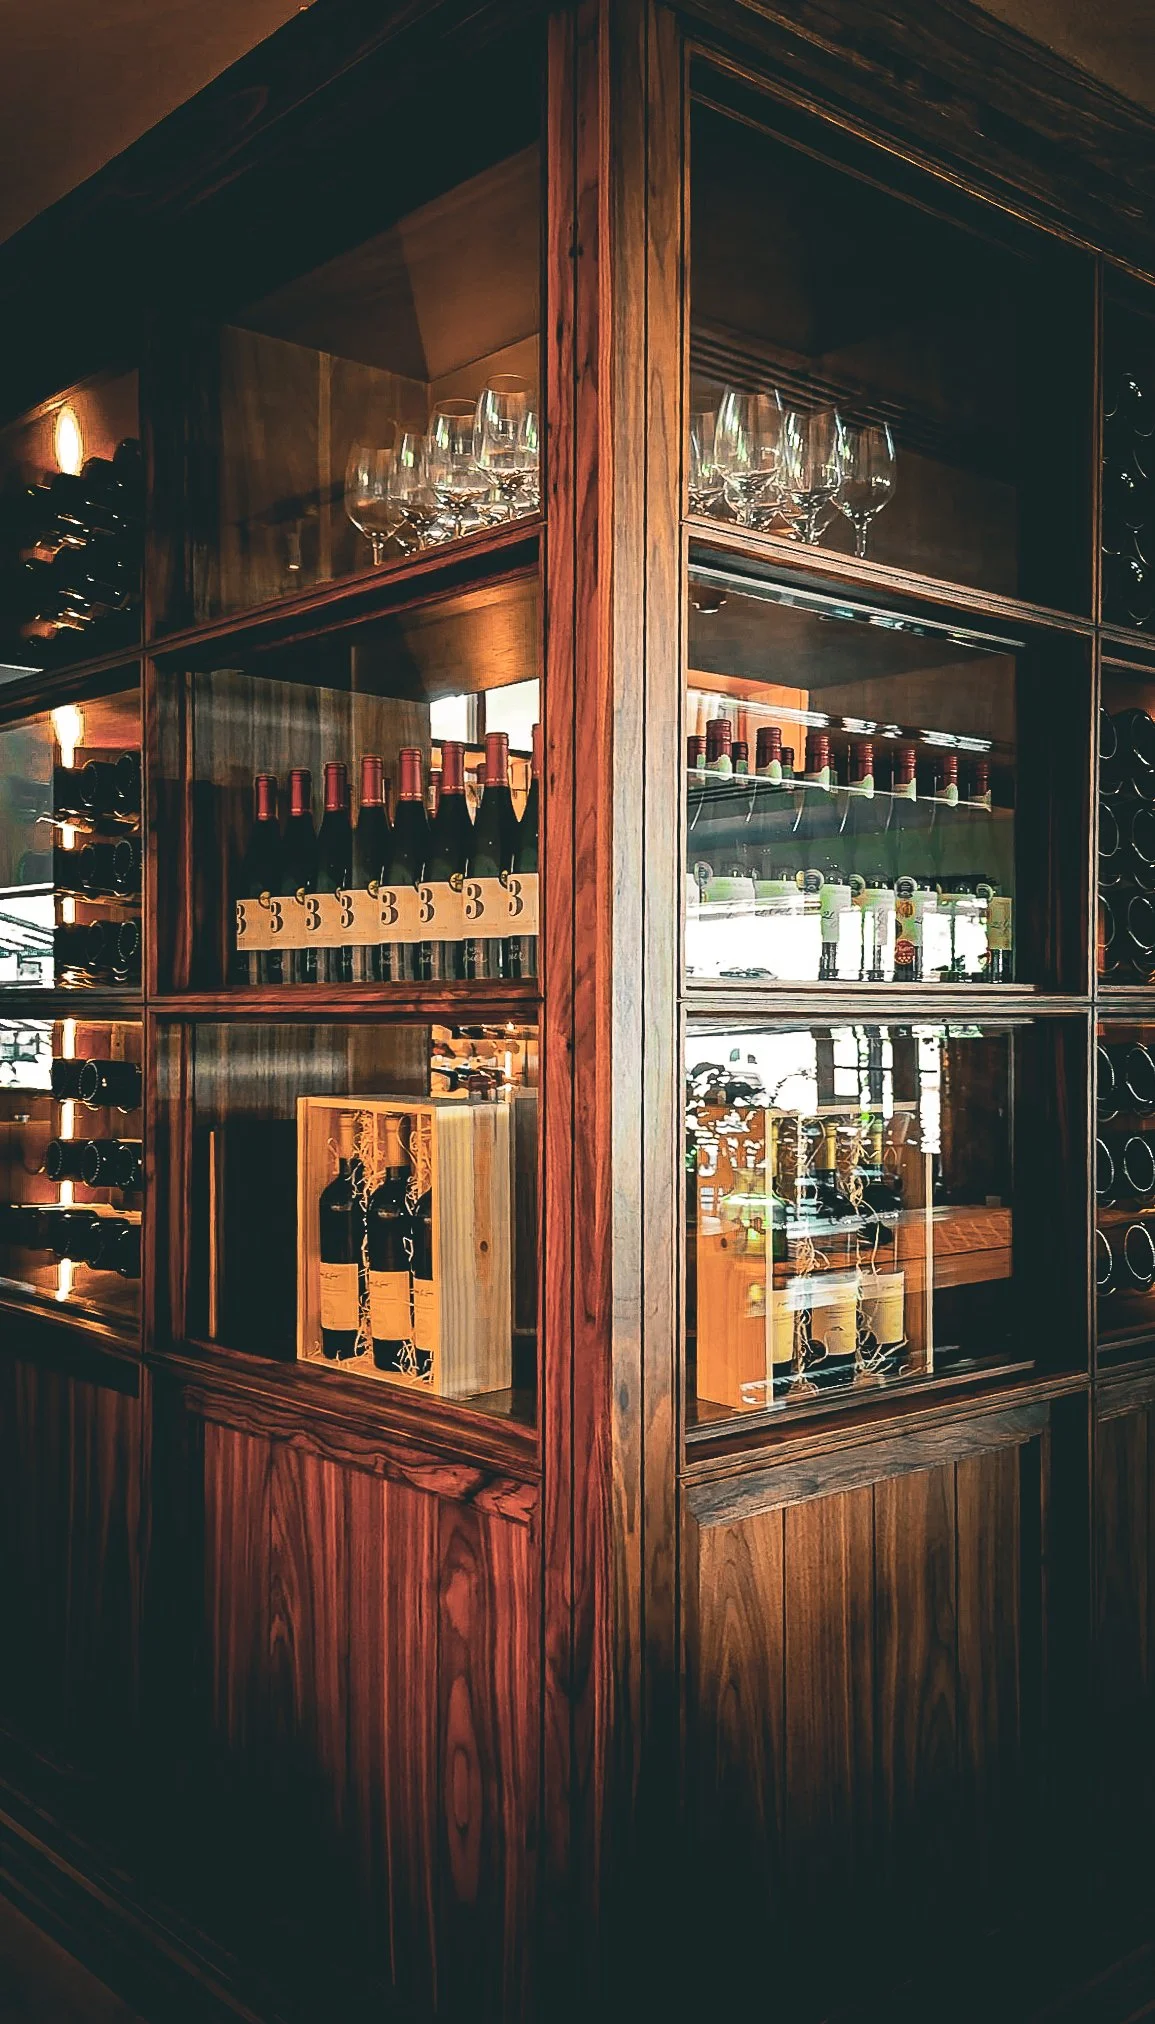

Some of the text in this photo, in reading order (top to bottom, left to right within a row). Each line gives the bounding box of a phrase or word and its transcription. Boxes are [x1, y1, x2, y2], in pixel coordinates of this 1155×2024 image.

[306, 899, 322, 930] 3
[341, 895, 354, 928] 3
[381, 891, 399, 925] 3
[420, 888, 435, 923] 3
[466, 883, 485, 920] 3
[508, 879, 523, 916] 3
[270, 901, 283, 933] 3
